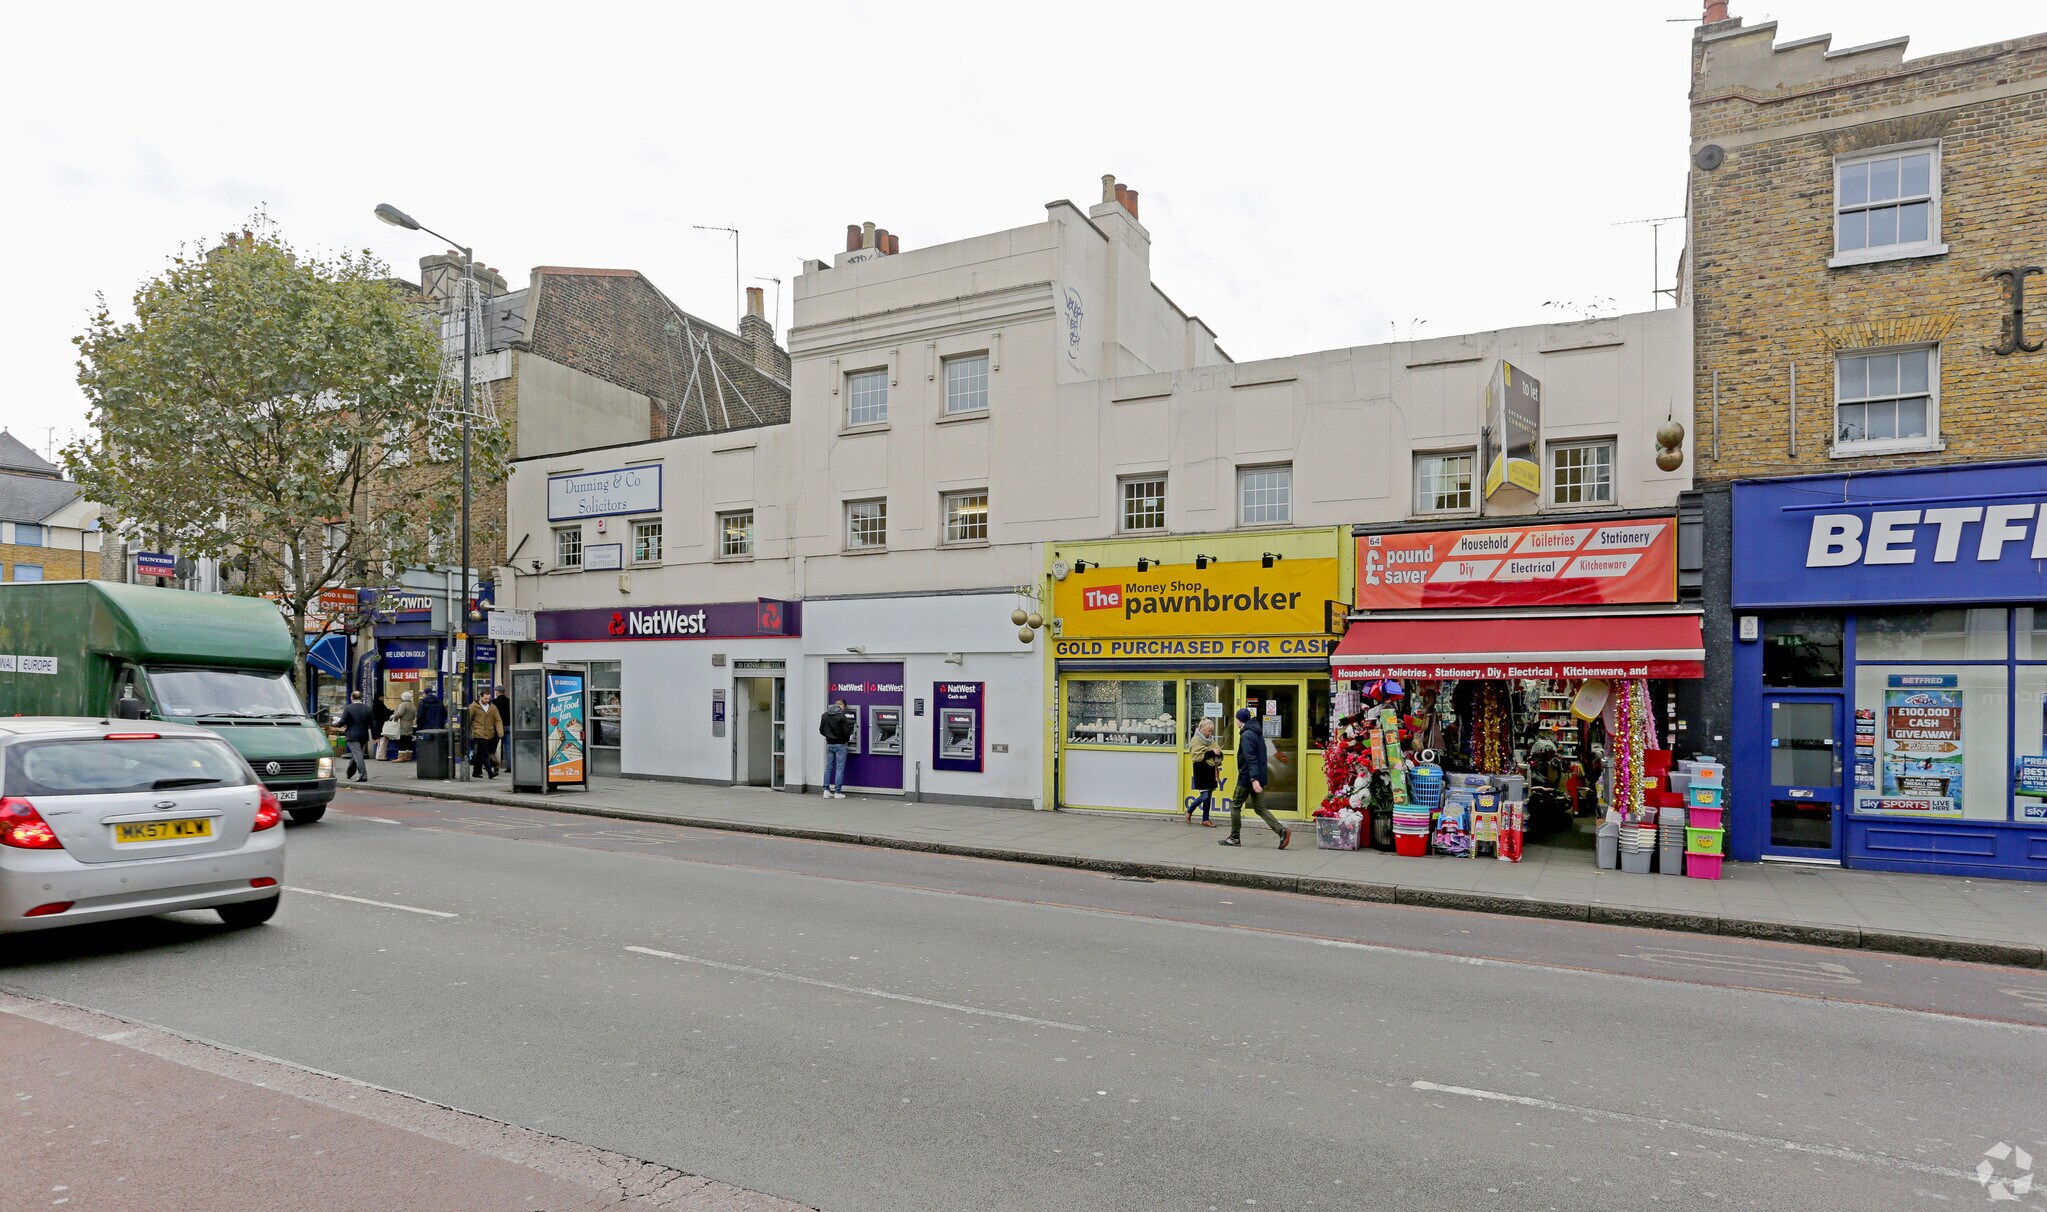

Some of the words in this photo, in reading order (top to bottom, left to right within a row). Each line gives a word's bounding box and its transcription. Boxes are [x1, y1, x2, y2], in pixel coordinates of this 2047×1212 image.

[1522, 380, 1530, 396] to
[1530, 381, 1539, 402] let
[565, 479, 609, 494] Dunning
[613, 473, 622, 489] &
[625, 472, 641, 488] Co
[578, 495, 627, 514] Solicitors
[1369, 537, 1380, 546] 64
[1461, 534, 1509, 551] Household
[1531, 534, 1575, 547] Toiletries
[1601, 530, 1650, 546] Stationery
[1386, 544, 1434, 568] pound
[1459, 562, 1474, 578] Diy
[1511, 561, 1556, 574] Electrical
[1580, 559, 1628, 571] Kitchenware
[1384, 569, 1428, 585] saver
[1126, 582, 1167, 595] Money
[1170, 580, 1202, 592] Shop
[321, 601, 355, 611] OPEN
[1086, 590, 1119, 607] The
[1126, 586, 1301, 620] pawnbroker
[629, 609, 706, 635] NatWest
[490, 625, 525, 637] Solicitors
[1056, 641, 1103, 655] GOLD
[1111, 640, 1224, 655] PURCHASED
[1231, 640, 1270, 654] FOR
[1279, 639, 1330, 654] CASH
[23, 659, 52, 671] EUROPE
[1629, 666, 1648, 675] and
[391, 671, 403, 679] SALE
[838, 684, 864, 692] NatWest
[877, 684, 904, 692] NatWest
[948, 685, 976, 693] NatWest
[551, 703, 563, 713] hot
[564, 698, 579, 711] food
[560, 711, 572, 721] fan
[1898, 708, 1950, 717] £100,000
[1908, 719, 1939, 728] CASH
[1895, 730, 1953, 740] GIVEAWAY
[280, 792, 296, 800] ZKE
[1861, 799, 1879, 809] sky
[1882, 800, 1929, 809] SPORTS
[2026, 807, 2046, 817] sky
[122, 823, 168, 839] MK57
